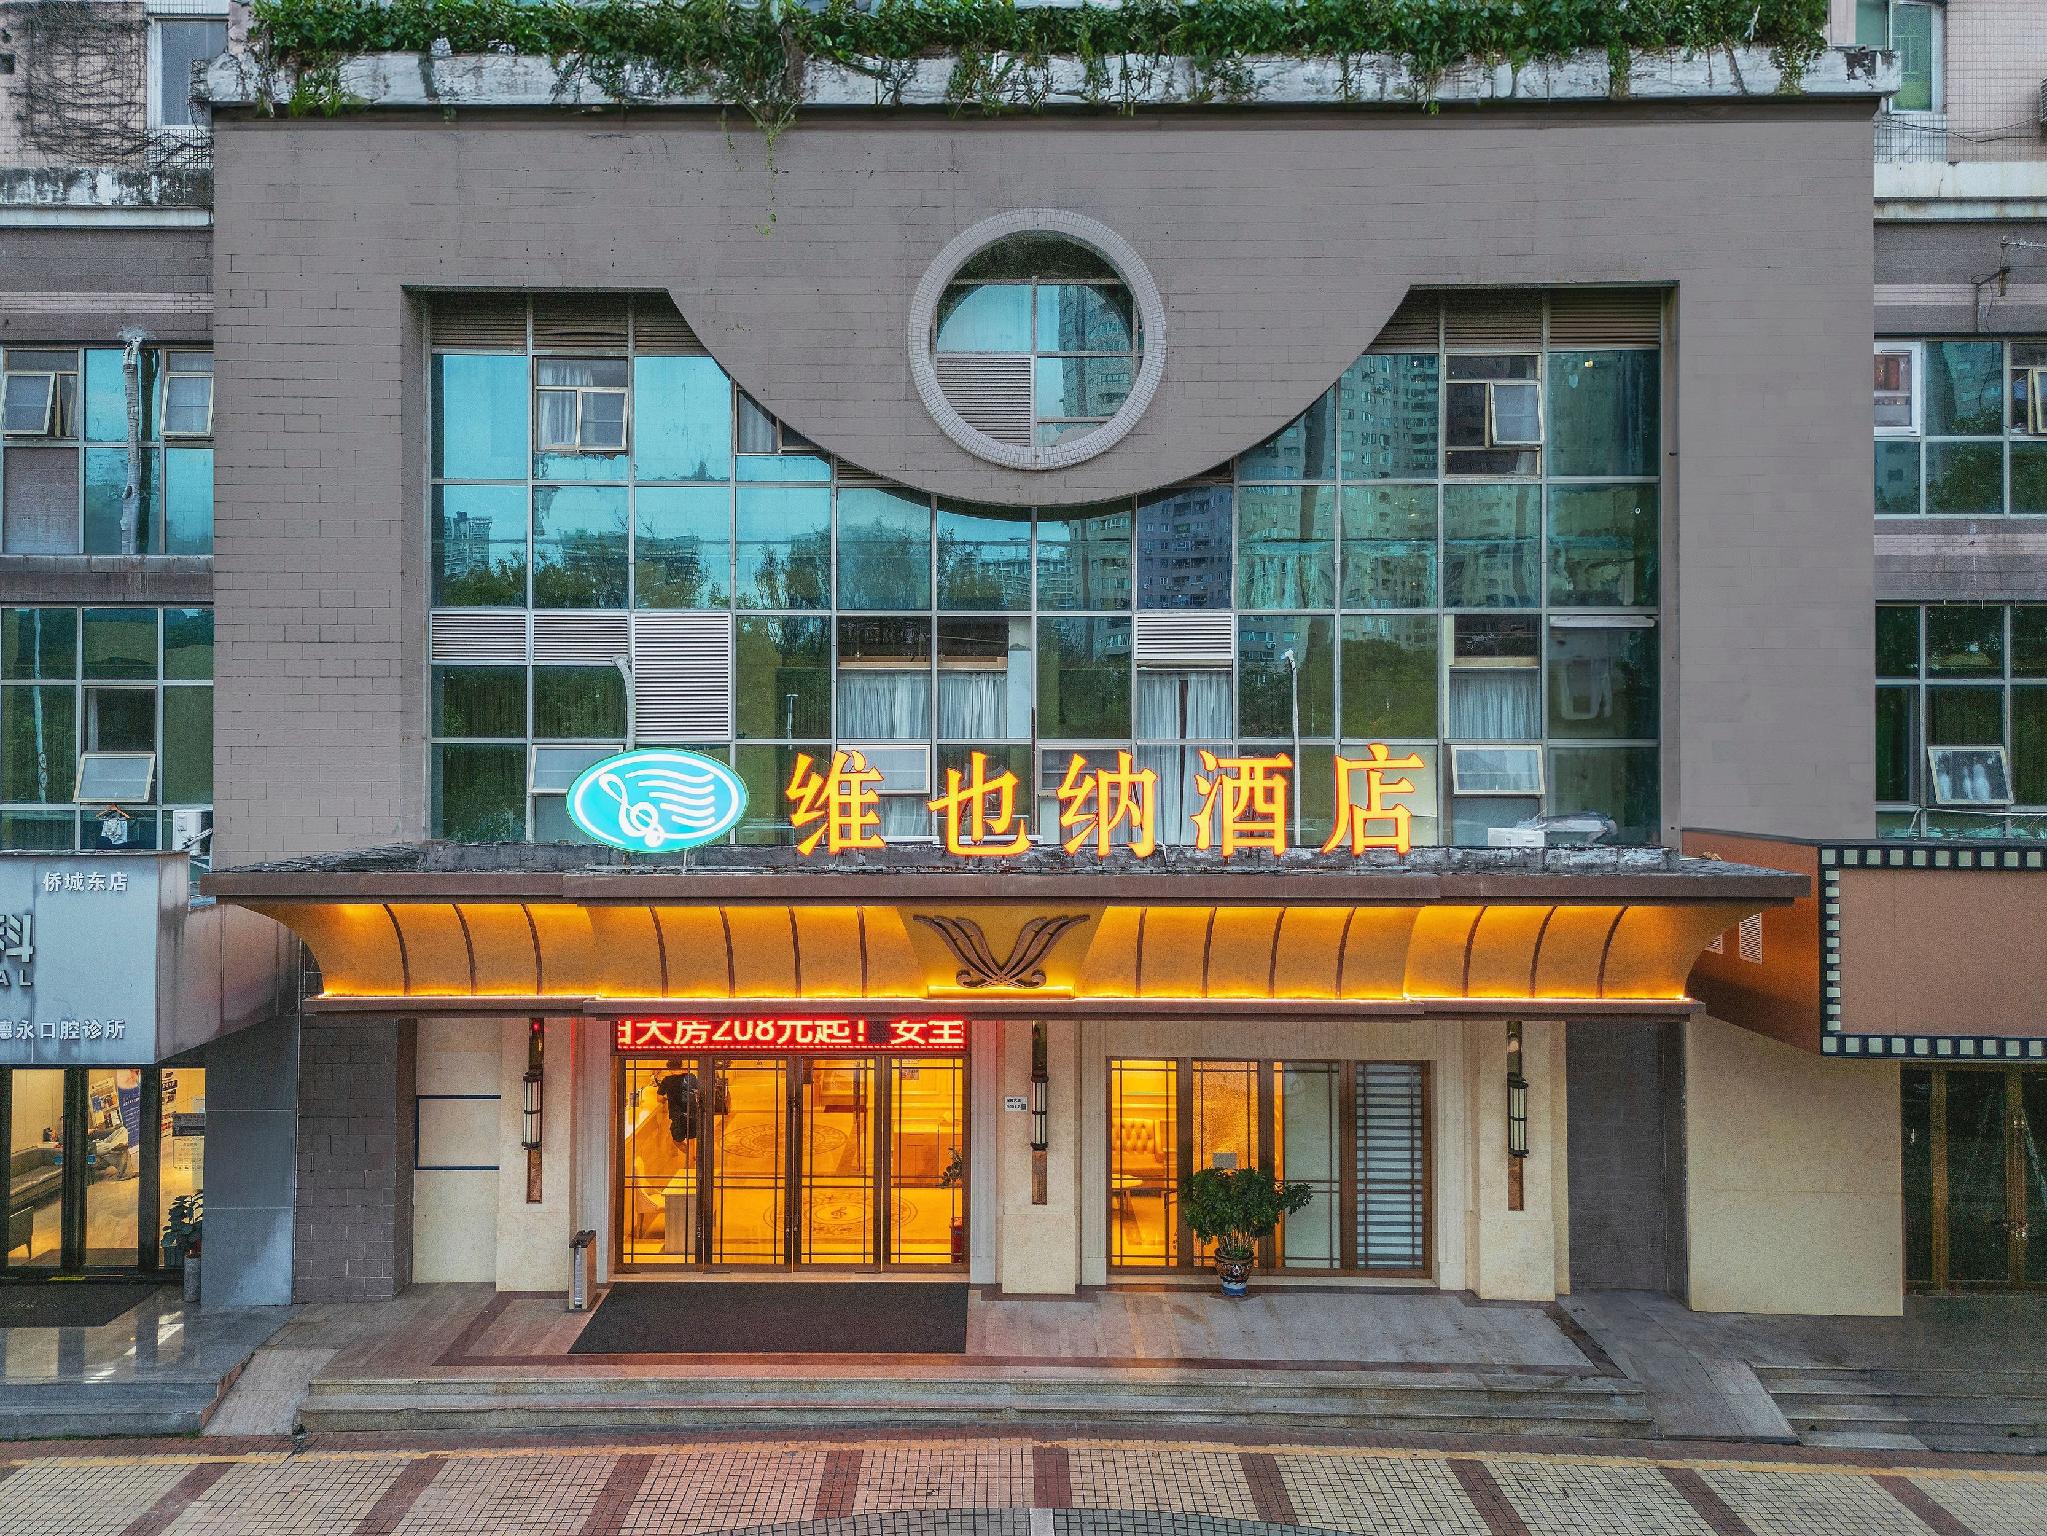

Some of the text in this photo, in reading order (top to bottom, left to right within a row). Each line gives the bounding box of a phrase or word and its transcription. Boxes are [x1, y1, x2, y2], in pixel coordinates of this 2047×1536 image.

[785, 743, 1425, 857] 维也纳酒店
[42, 871, 128, 892] 侨城东店
